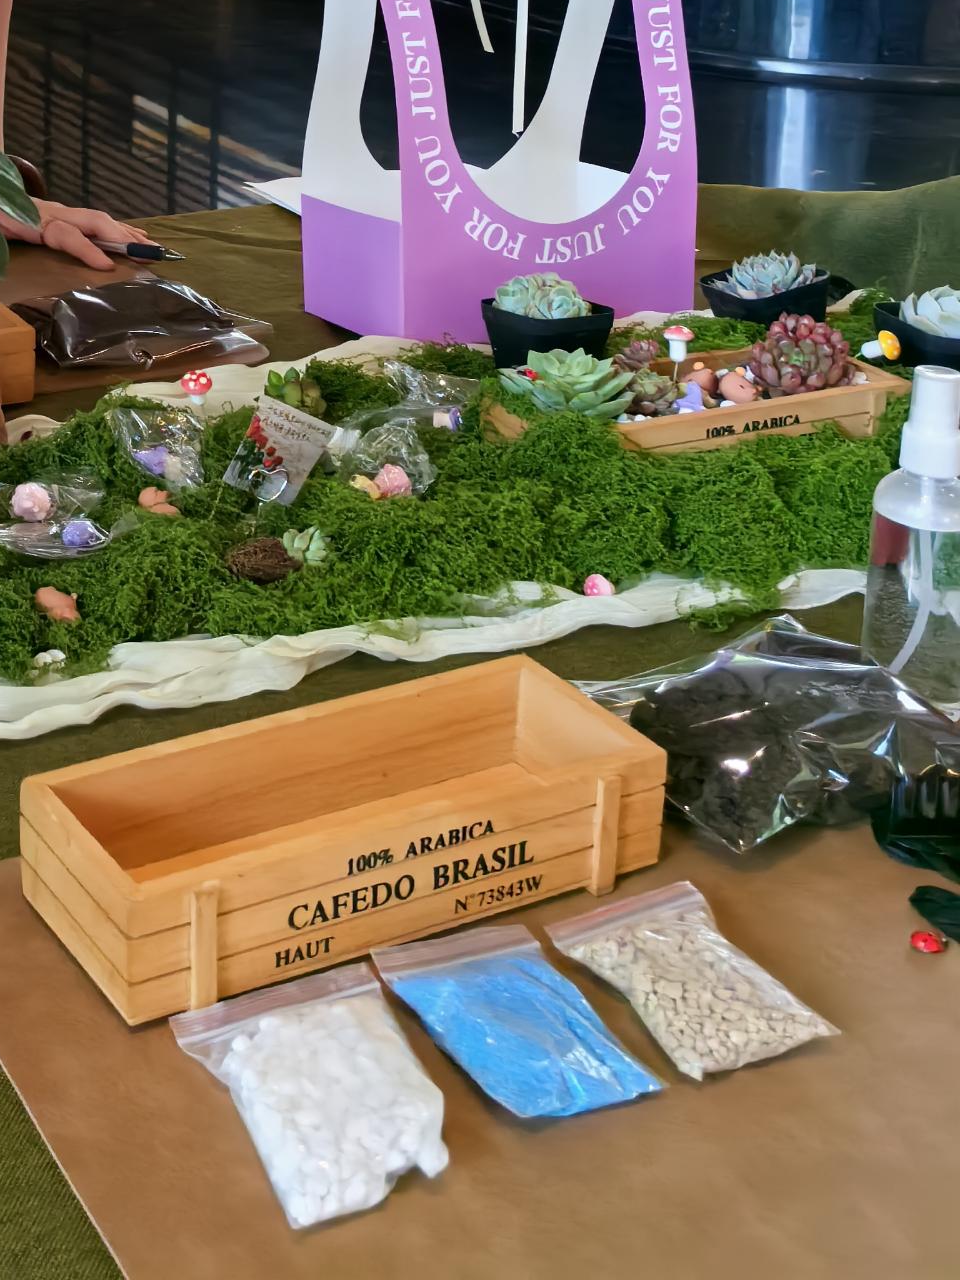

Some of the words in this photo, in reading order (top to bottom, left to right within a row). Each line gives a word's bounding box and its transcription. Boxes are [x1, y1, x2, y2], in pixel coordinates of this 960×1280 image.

[401, 31, 438, 121] JUST
[656, 83, 683, 153] FOR
[414, 135, 464, 214] YOU
[617, 166, 671, 235] YOU
[464, 207, 526, 261] FOR
[534, 222, 607, 264] JUST
[743, 414, 801, 433] ARABICA
[346, 848, 394, 877] 100%
[404, 819, 495, 860] ARABICA
[287, 874, 416, 931] CAFEDO
[432, 840, 535, 891] BRASIL
[274, 936, 336, 969] HAUT
